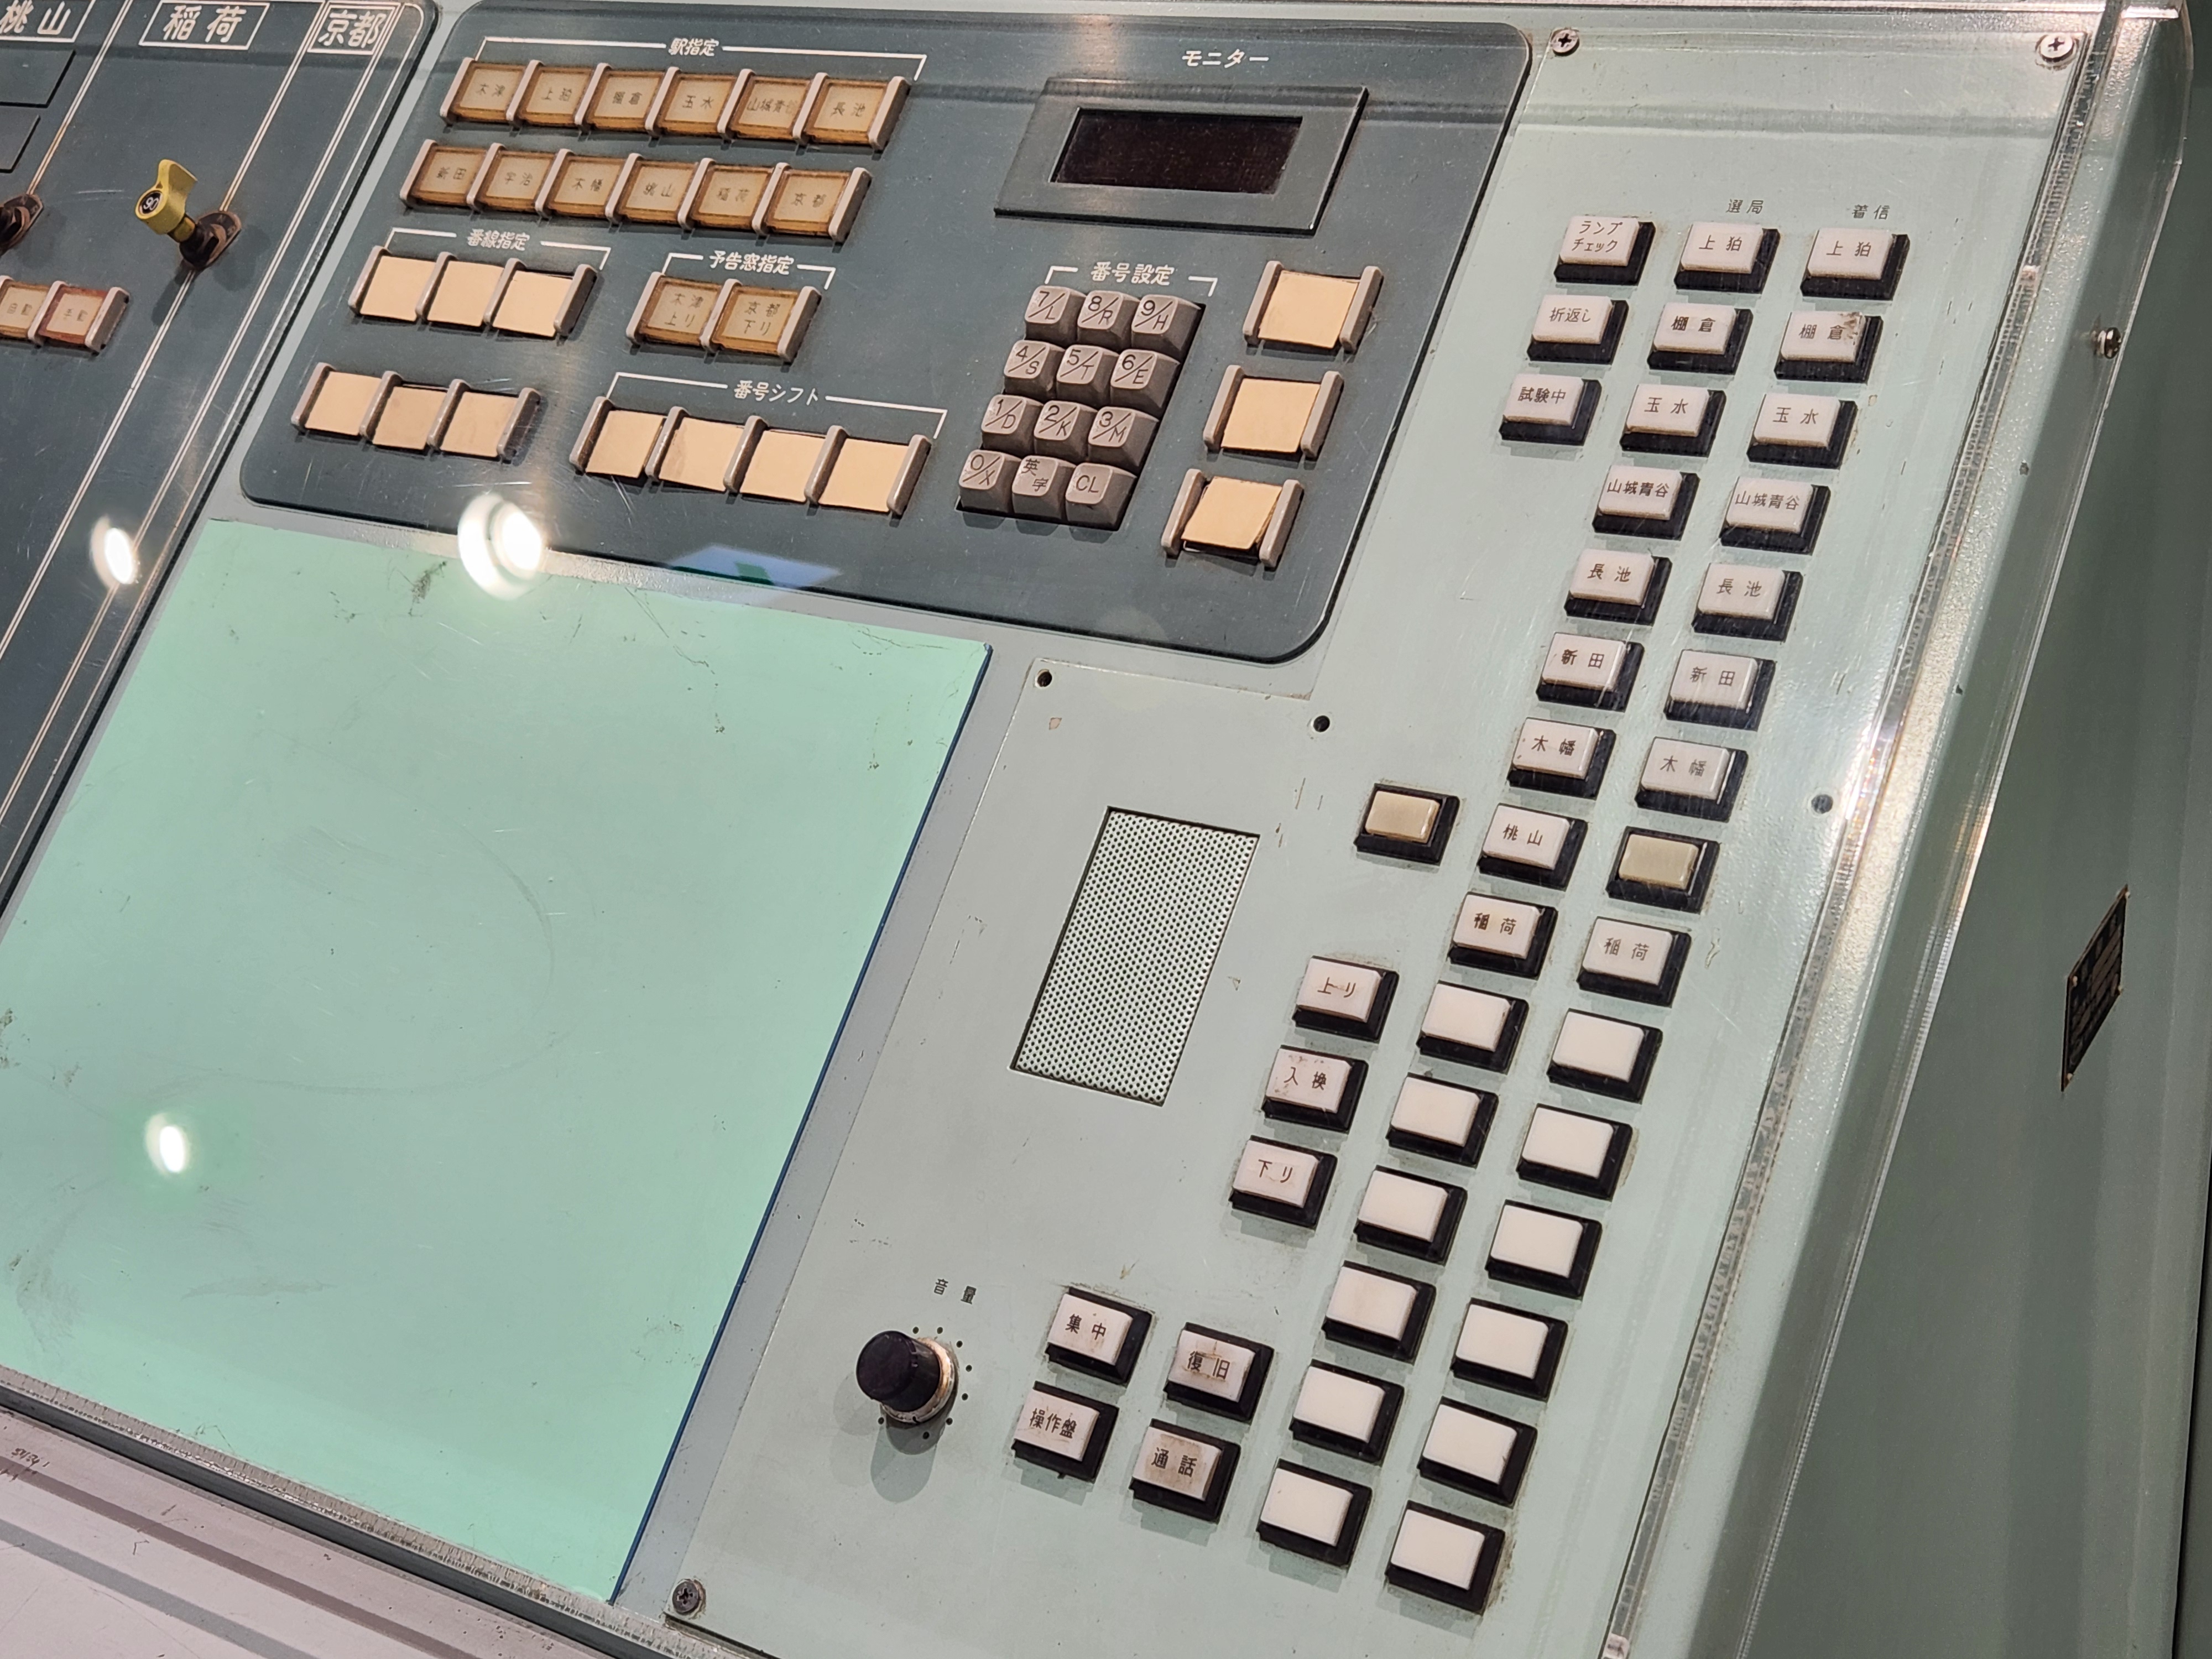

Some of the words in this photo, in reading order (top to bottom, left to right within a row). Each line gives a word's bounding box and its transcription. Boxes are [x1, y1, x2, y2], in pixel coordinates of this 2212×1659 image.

[0, 0, 71, 35] 桃山
[163, 5, 247, 43] 稲荷
[319, 9, 387, 48] 京都
[668, 38, 719, 56] 駅指定
[1182, 49, 1269, 69] モニター
[1726, 199, 1763, 215] 選局
[1852, 204, 1890, 220] 着信
[1579, 220, 1623, 236] ランプ
[467, 228, 530, 251] 番線指定
[1572, 237, 1618, 253] チェック
[1699, 236, 1743, 252] 上狛
[1826, 241, 1872, 257] 上狛
[709, 250, 795, 275] 予告窓指定
[1091, 261, 1175, 285] 番号設定
[1549, 306, 1591, 323] 折返し
[1671, 316, 1716, 333] 棚倉
[1798, 324, 1843, 341] 棚倉
[733, 380, 819, 406] 番号シフト
[1517, 387, 1567, 404] 試験中
[1645, 397, 1688, 415] 玉水
[1772, 407, 1819, 425] 玉水
[1076, 475, 1099, 493] CL
[1606, 478, 1670, 498] 山城青谷
[1735, 491, 1801, 510] 山城青谷
[1587, 563, 1631, 582] 長池
[1716, 578, 1762, 598] 長池
[1561, 649, 1605, 669] 新田
[1689, 666, 1735, 686] 新田
[1531, 735, 1577, 756] 木幡
[1660, 755, 1707, 778] 木幡
[1502, 823, 1543, 846] 桃山
[1473, 912, 1517, 935] 稲荷
[1604, 937, 1650, 961] 稲荷
[1284, 1067, 1327, 1089] 入換
[934, 1278, 977, 1305] 音量
[1065, 1313, 1107, 1341] 集中
[1187, 1350, 1230, 1380] 復旧
[1029, 1407, 1078, 1439] 操作盤
[1151, 1447, 1197, 1478] 通話
